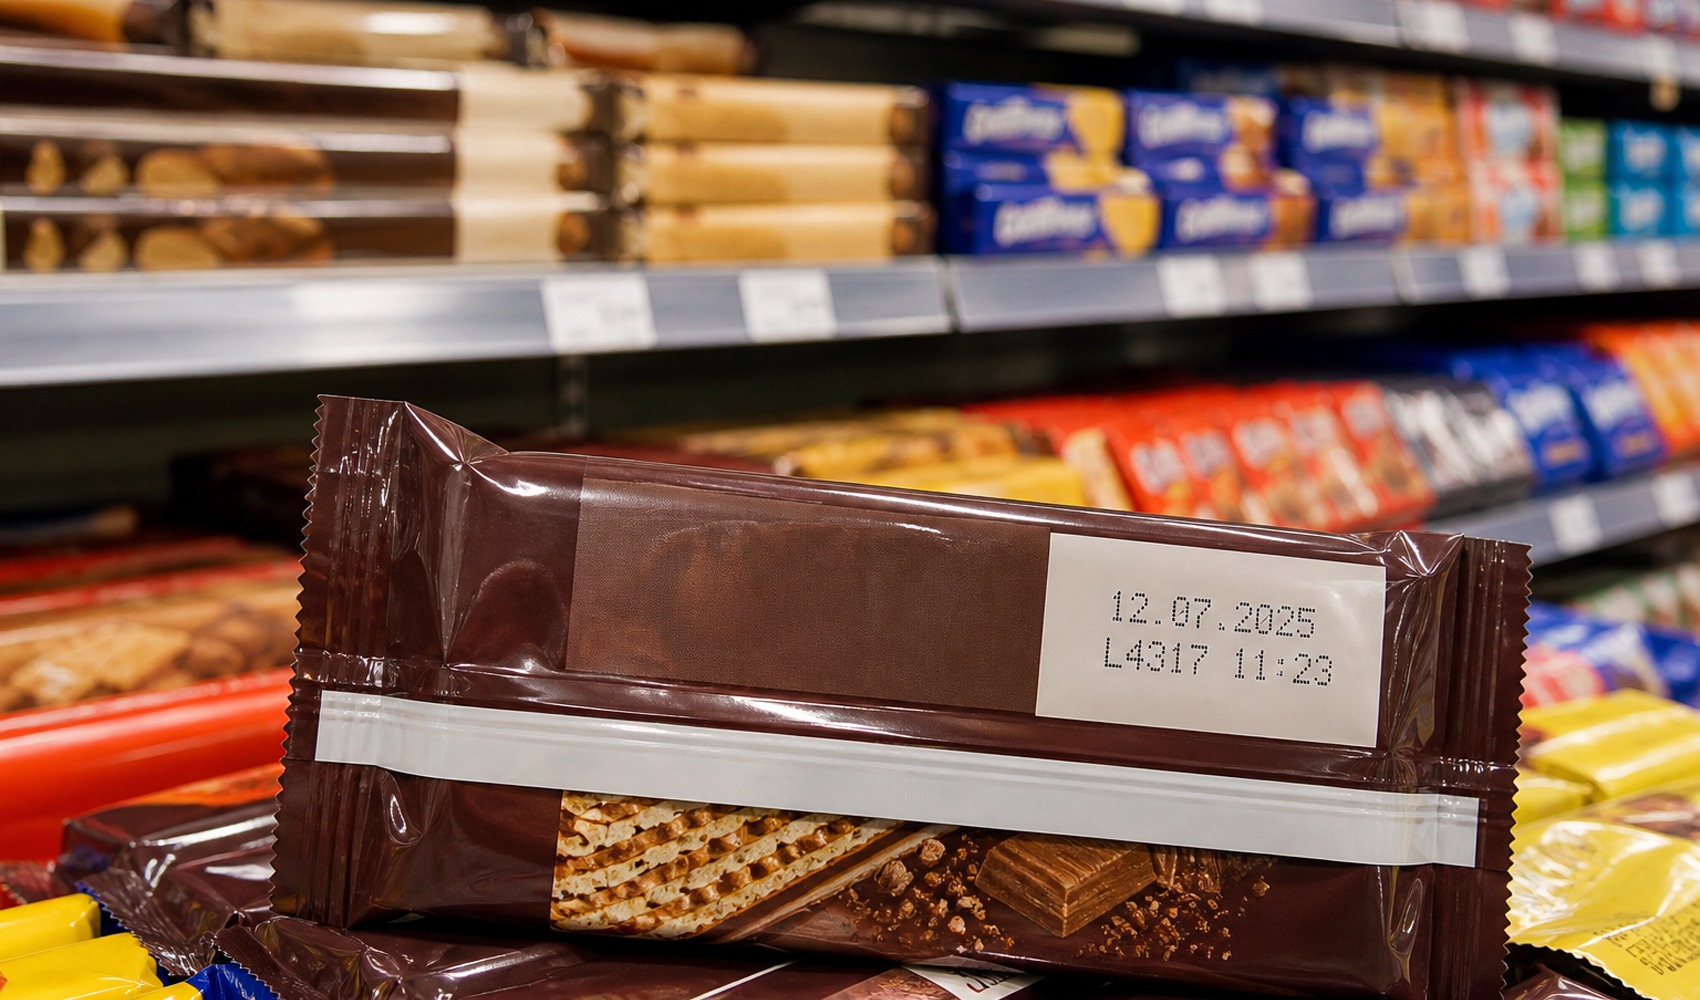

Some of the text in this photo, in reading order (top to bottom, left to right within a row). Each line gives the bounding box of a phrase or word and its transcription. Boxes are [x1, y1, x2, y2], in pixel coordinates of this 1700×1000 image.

[1112, 590, 1316, 638] 12.07.2025
[1104, 636, 1333, 687] L4317 11:23
